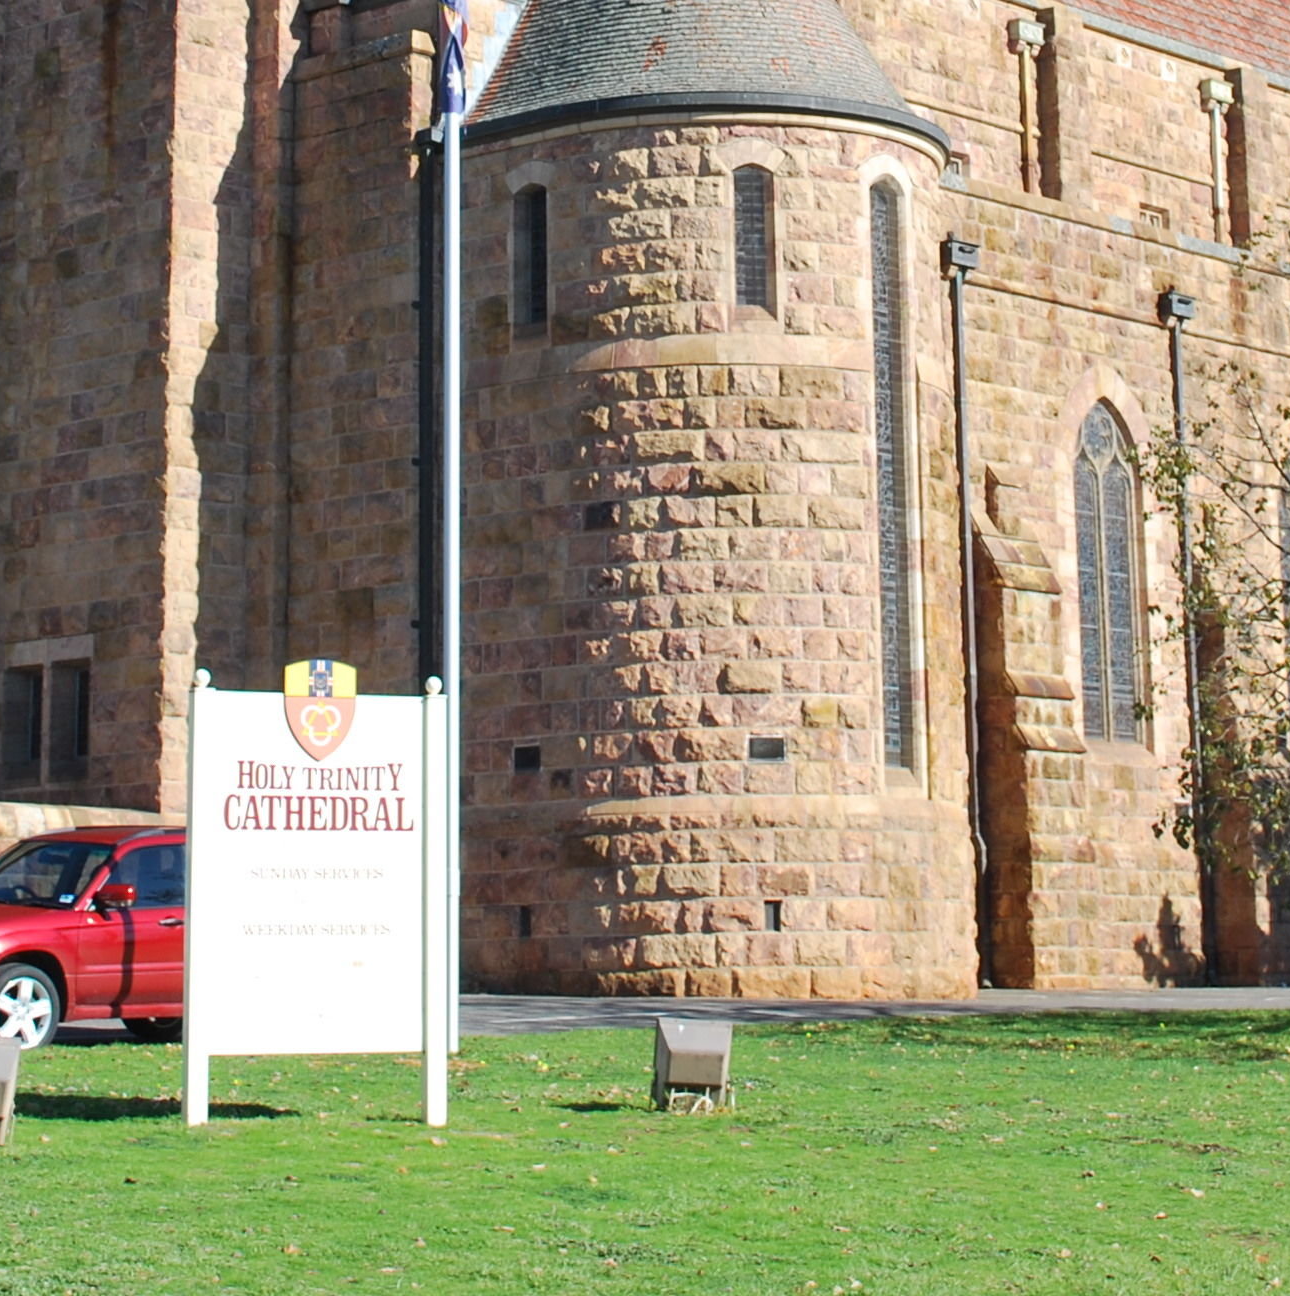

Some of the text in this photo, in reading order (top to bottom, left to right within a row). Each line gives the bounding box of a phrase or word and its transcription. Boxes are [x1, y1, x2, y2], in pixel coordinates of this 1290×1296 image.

[237, 760, 403, 791] HOLY TRINITY
[223, 794, 414, 832] CATHEDRAL
[250, 867, 384, 880] SUNDAY SERVICES
[242, 923, 391, 936] WEEKDAY SERVICES
